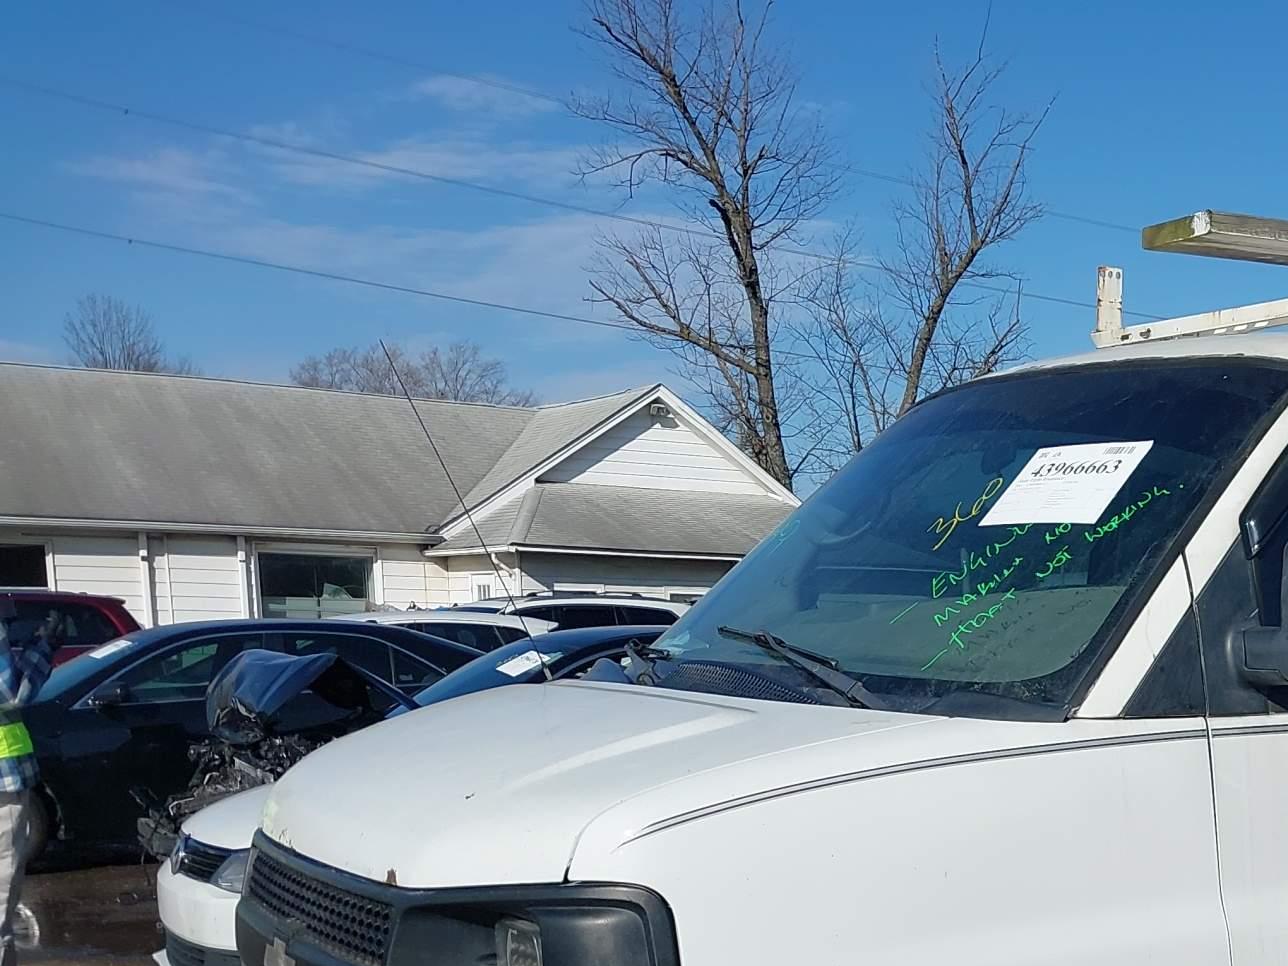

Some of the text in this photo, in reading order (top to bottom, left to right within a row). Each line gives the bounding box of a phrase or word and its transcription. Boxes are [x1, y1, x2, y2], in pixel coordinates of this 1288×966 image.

[1030, 458, 1123, 479] 43966663
[926, 477, 1004, 551] 360
[1034, 545, 1072, 578] NOT
